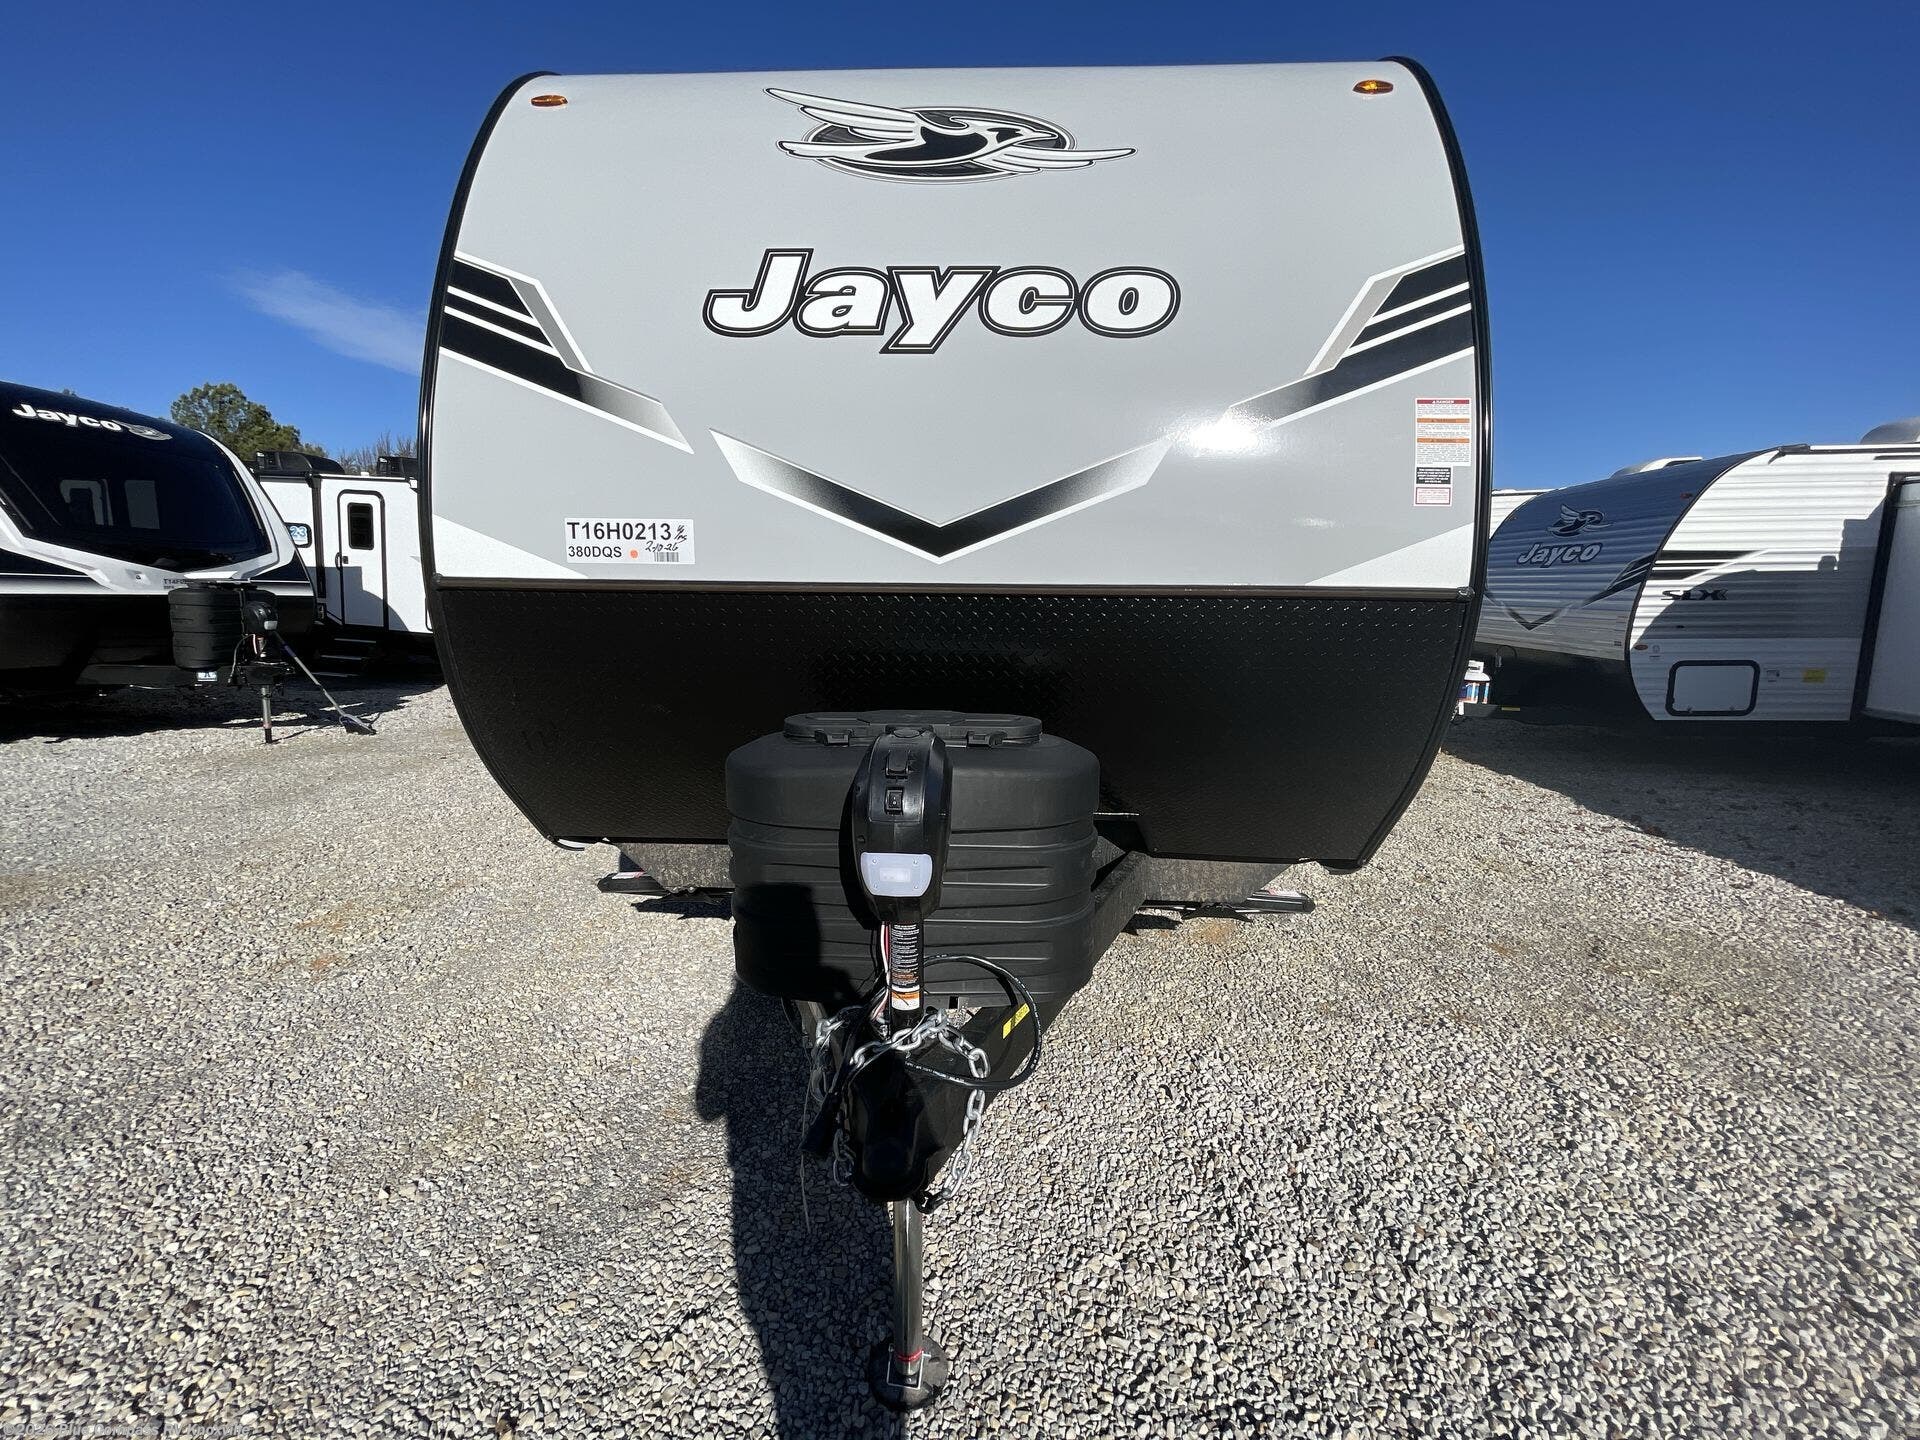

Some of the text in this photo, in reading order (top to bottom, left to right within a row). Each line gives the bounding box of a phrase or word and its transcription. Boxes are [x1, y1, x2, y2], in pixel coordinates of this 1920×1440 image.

[702, 248, 1182, 354] Jayco
[12, 403, 122, 432] Jayco
[567, 521, 672, 541] T16H0213
[568, 546, 622, 559] 380DQS
[1517, 542, 1603, 568] Jayco
[1661, 589, 1729, 601] SLX
